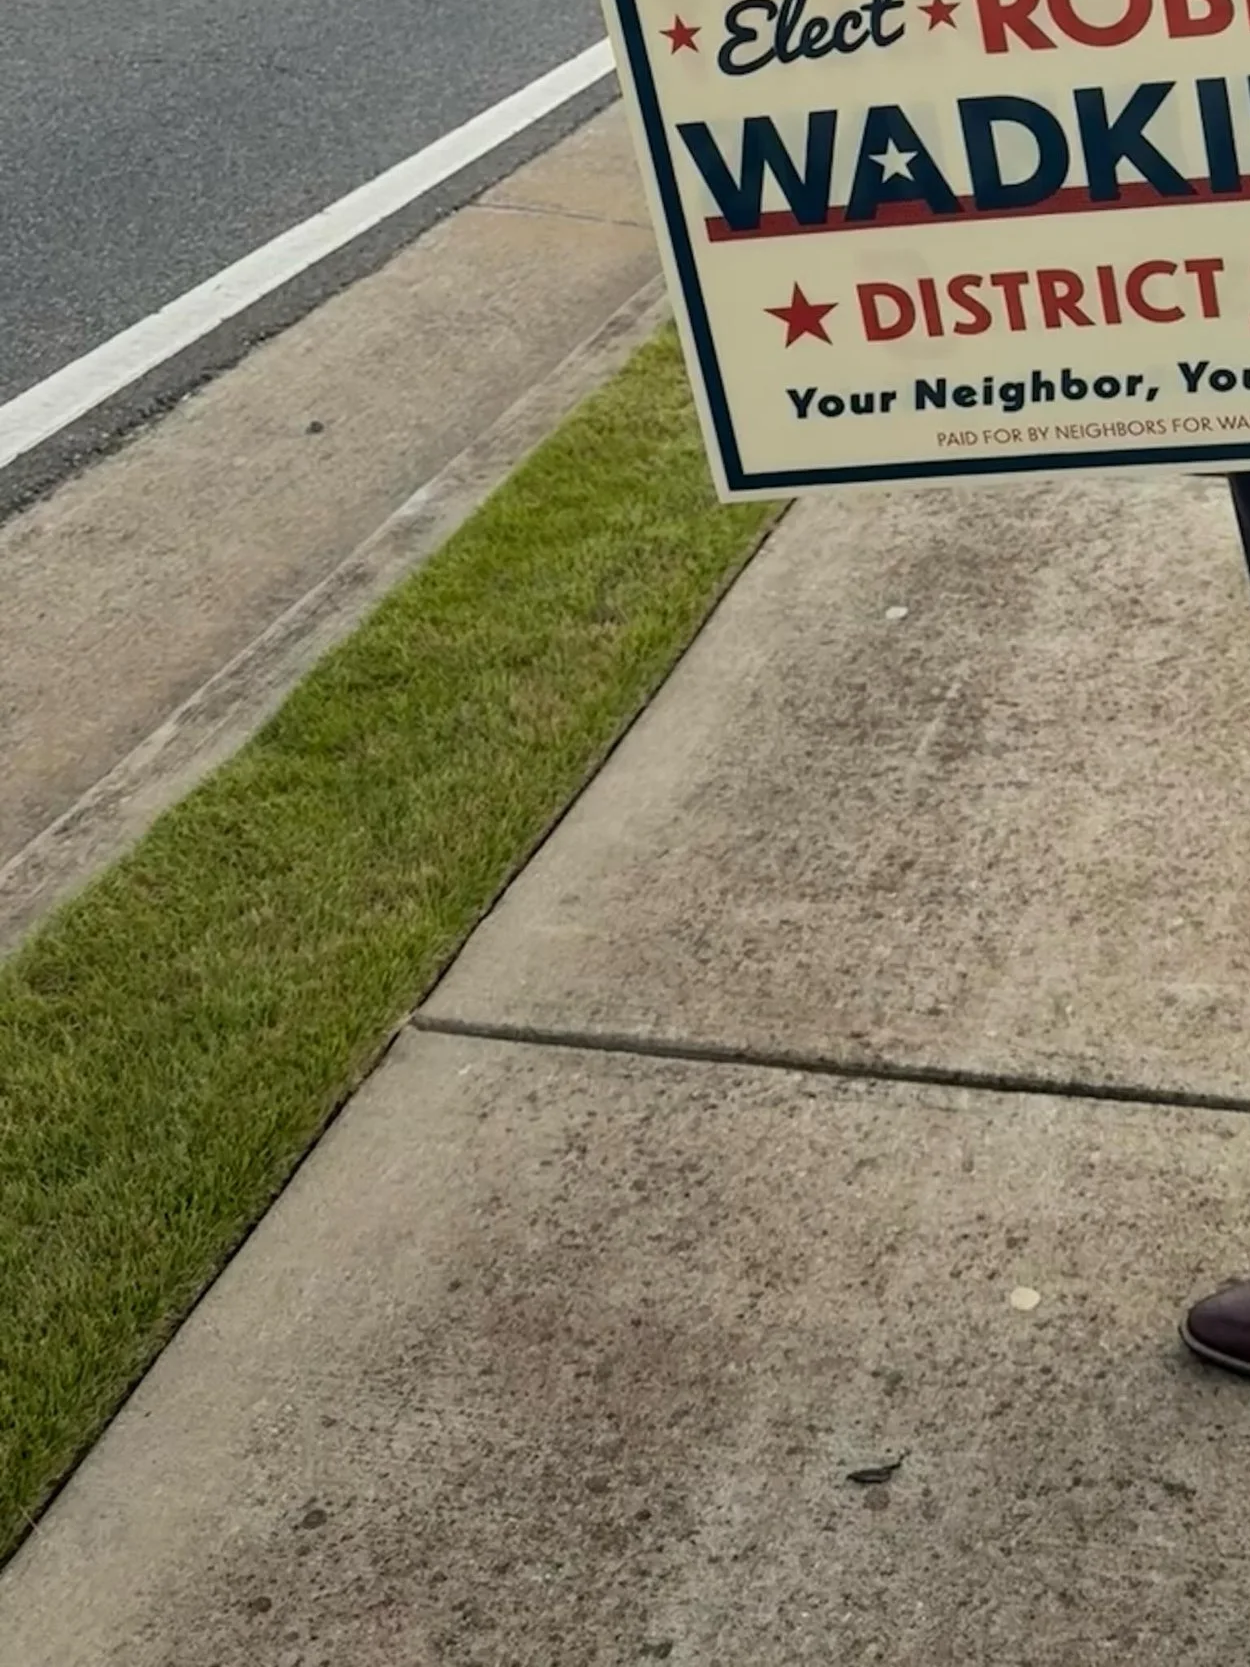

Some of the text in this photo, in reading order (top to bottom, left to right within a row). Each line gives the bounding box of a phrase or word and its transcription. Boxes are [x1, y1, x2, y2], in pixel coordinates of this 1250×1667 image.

[854, 255, 1227, 344] DISTRICT
[784, 386, 899, 421] Your
[913, 367, 1161, 413] Neighbor,
[936, 430, 979, 448] PAID
[982, 427, 1023, 445] FOR
[1026, 426, 1051, 443] BY
[1054, 418, 1168, 441] NEIGHBORS
[1171, 416, 1214, 434] FOR
